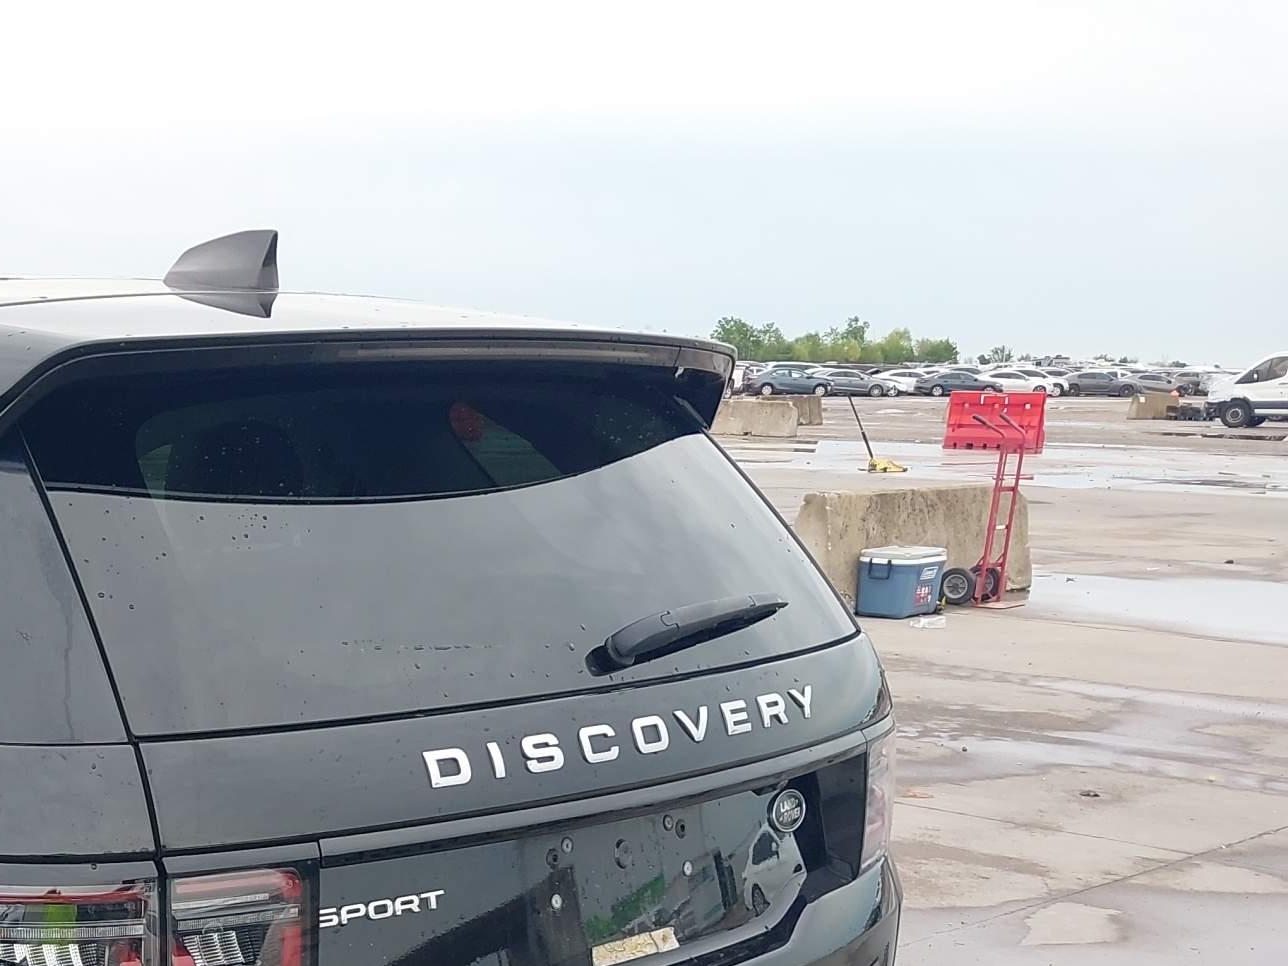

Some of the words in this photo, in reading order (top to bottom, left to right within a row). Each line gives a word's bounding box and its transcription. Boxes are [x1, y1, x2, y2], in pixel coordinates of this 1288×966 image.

[422, 685, 812, 788] DISCOVERY
[779, 797, 797, 813] LAND
[319, 889, 445, 928] SPORT
